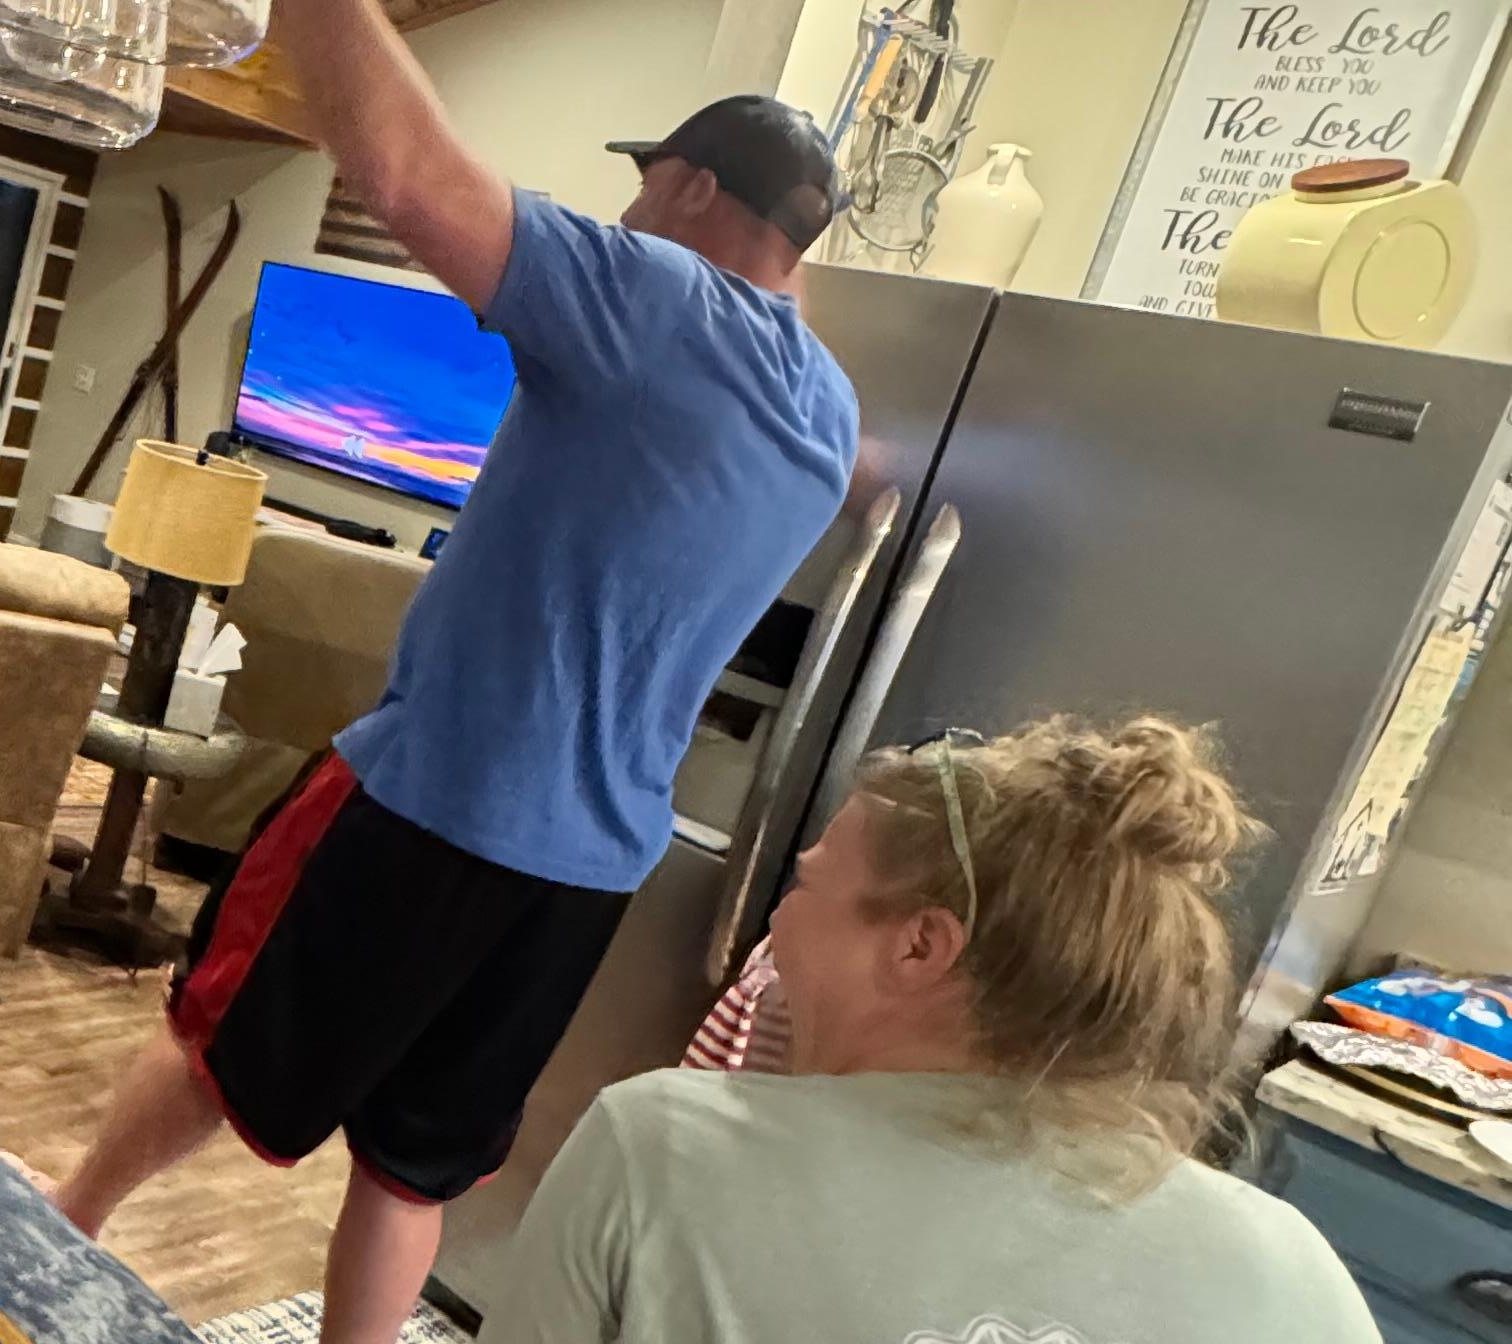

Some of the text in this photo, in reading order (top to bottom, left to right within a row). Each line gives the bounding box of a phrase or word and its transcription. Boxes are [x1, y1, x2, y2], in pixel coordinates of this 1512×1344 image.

[1238, 4, 1451, 57] The Lord
[1275, 56, 1375, 75] BLESS YOU
[1254, 74, 1382, 96] AND KEEP YOU
[1202, 96, 1411, 155] The Lord
[1220, 148, 1264, 166] MAKE
[1270, 150, 1304, 169] HIS
[1197, 167, 1284, 189] SHINE ON
[1179, 187, 1198, 203] BE
[1161, 209, 1232, 255] The
[1178, 259, 1221, 278] TURN
[1138, 295, 1169, 311] AND
